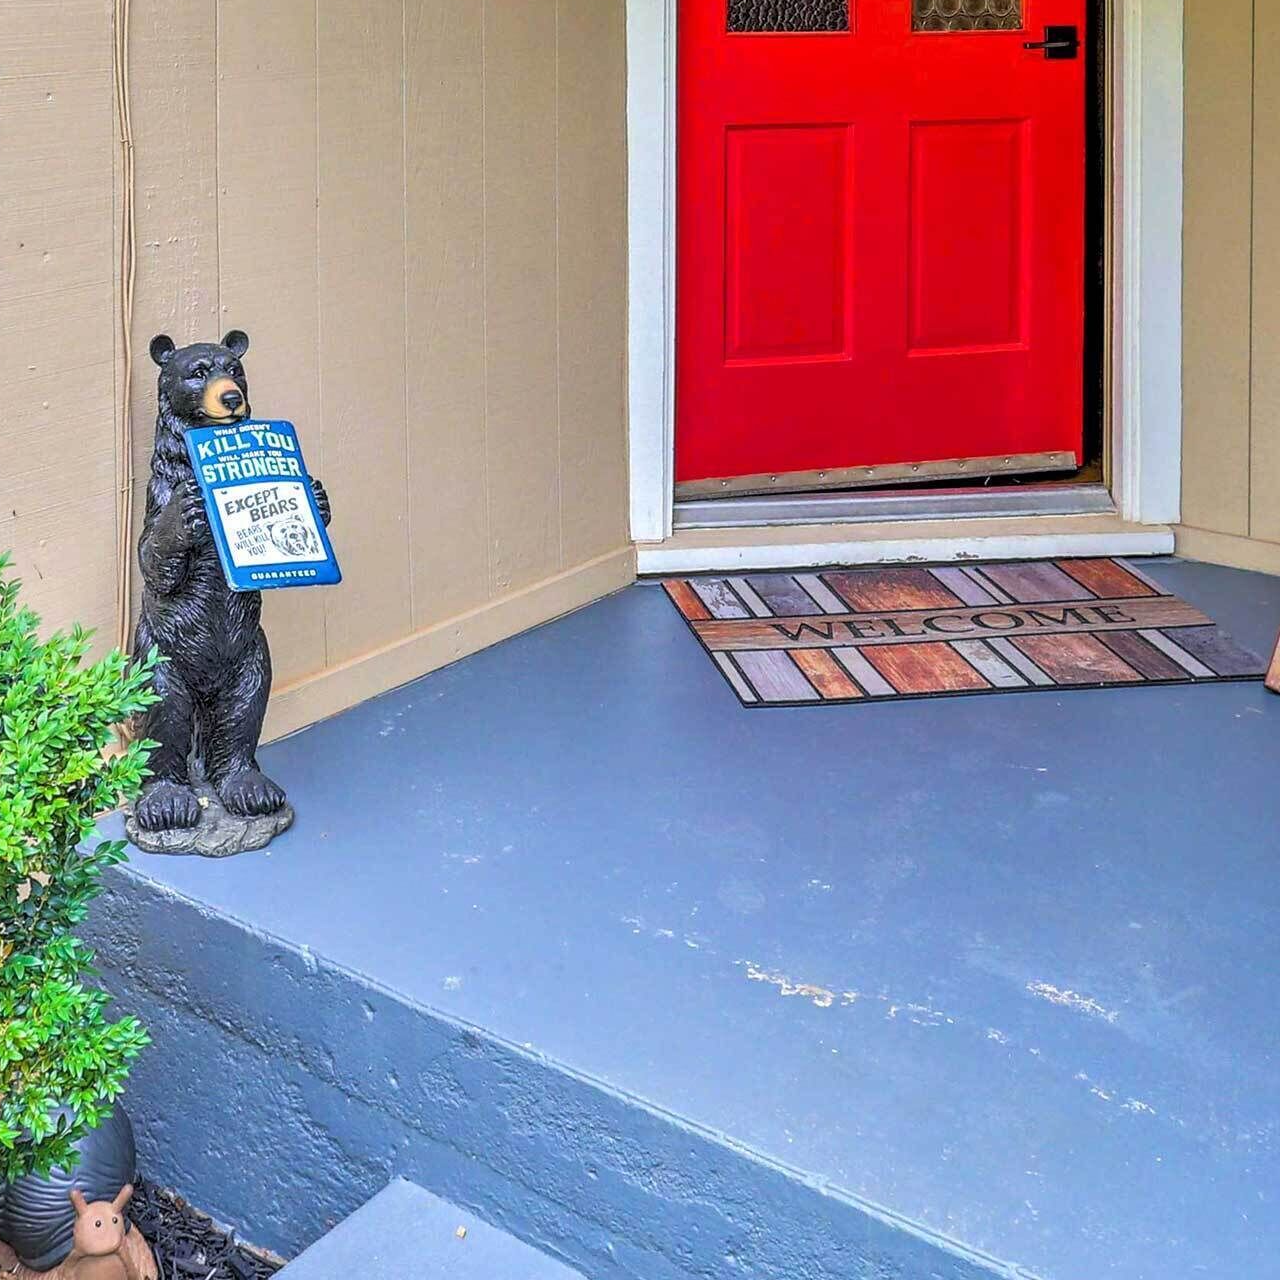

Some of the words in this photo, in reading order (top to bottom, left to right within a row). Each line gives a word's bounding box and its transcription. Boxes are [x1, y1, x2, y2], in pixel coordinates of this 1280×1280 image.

[214, 427, 237, 437] WHAT
[197, 434, 251, 460] KILL
[251, 431, 295, 452] YOU
[218, 454, 240, 463] WILL
[241, 450, 266, 458] MAKE
[267, 449, 283, 457] YOU
[201, 457, 303, 484] STRONGER
[224, 486, 279, 516] EXCEPT
[249, 497, 299, 522] BEARS
[236, 523, 262, 540] BEARS
[234, 538, 255, 551] WILL
[253, 532, 271, 544] KILL
[247, 543, 267, 557] YOU!
[251, 569, 317, 581] GUARANTEED
[771, 604, 1137, 642] WELCOME
